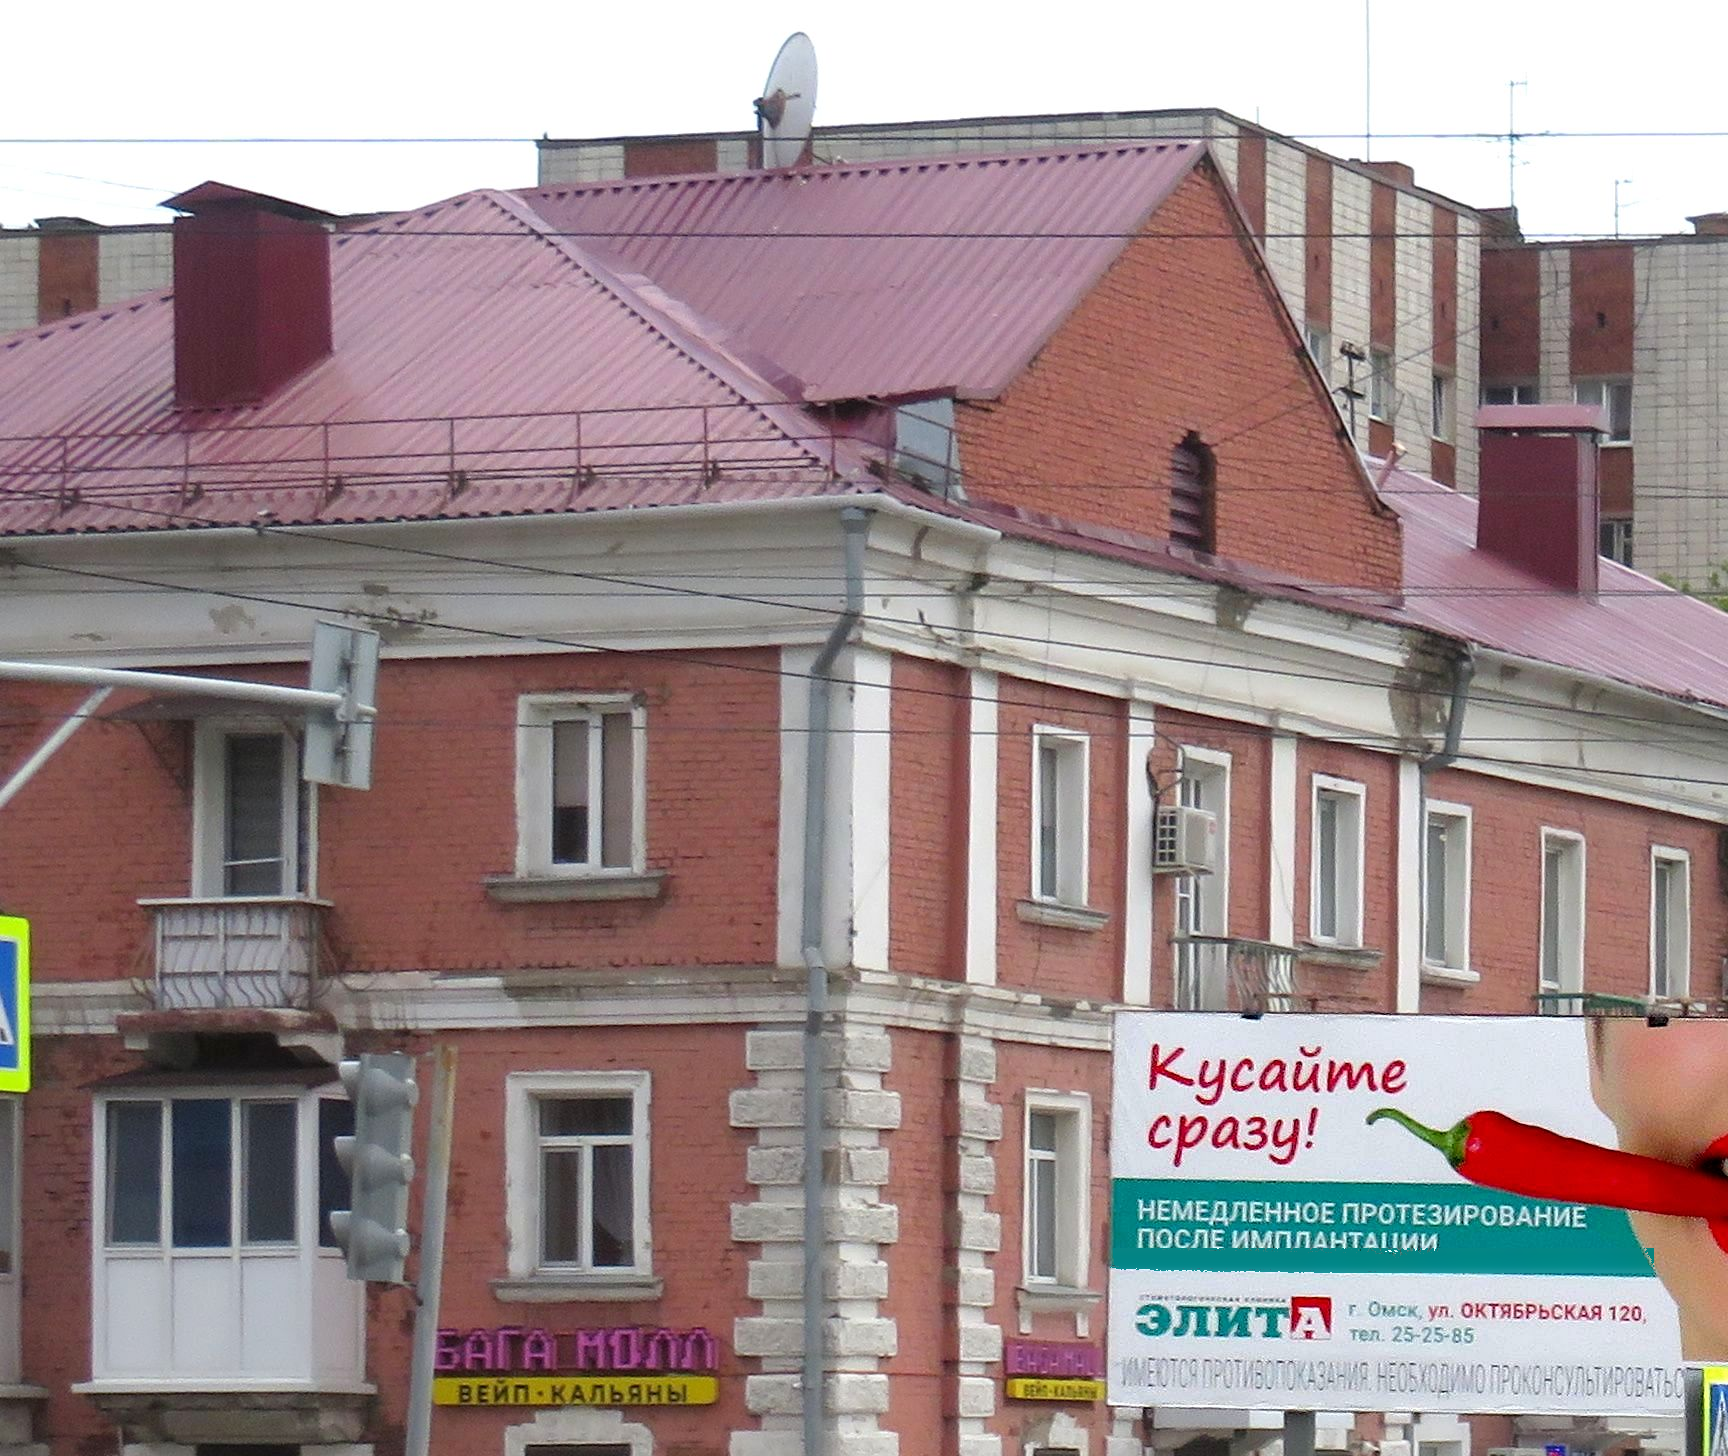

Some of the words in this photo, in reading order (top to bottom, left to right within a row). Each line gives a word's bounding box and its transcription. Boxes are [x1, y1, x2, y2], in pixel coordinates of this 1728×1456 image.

[1149, 1043, 1408, 1105] Кусайте
[1148, 1107, 1319, 1167] сразу!
[1137, 1199, 1335, 1225] НЕМЕДЛЕННОЕ
[1342, 1202, 1588, 1229] ПРОТЕЗИРОВАНИЕ
[1137, 1228, 1224, 1249] ПОСЛЕ
[1232, 1231, 1439, 1252] ИМПЛАНТАЦИИ
[1135, 1296, 1332, 1340] ЭЛИТА
[1368, 1301, 1422, 1320] Омск,
[1428, 1305, 1454, 1322] ул.
[1461, 1303, 1602, 1322] ОКТЯБРЬСКАЯ
[1609, 1306, 1648, 1325] 120,
[1350, 1328, 1386, 1342] тел.
[1391, 1327, 1475, 1344] 25-25-85
[458, 1380, 530, 1403] ВЕЙП
[551, 1384, 688, 1403] КАЛЬЯНЫ
[1120, 1357, 1198, 1389] ИМЕЮТСЯ
[1376, 1360, 1485, 1400] НЕОБХОДИМО
[1490, 1363, 1685, 1399] ПРОКОНСУЛЬТИРОВАТЬС
